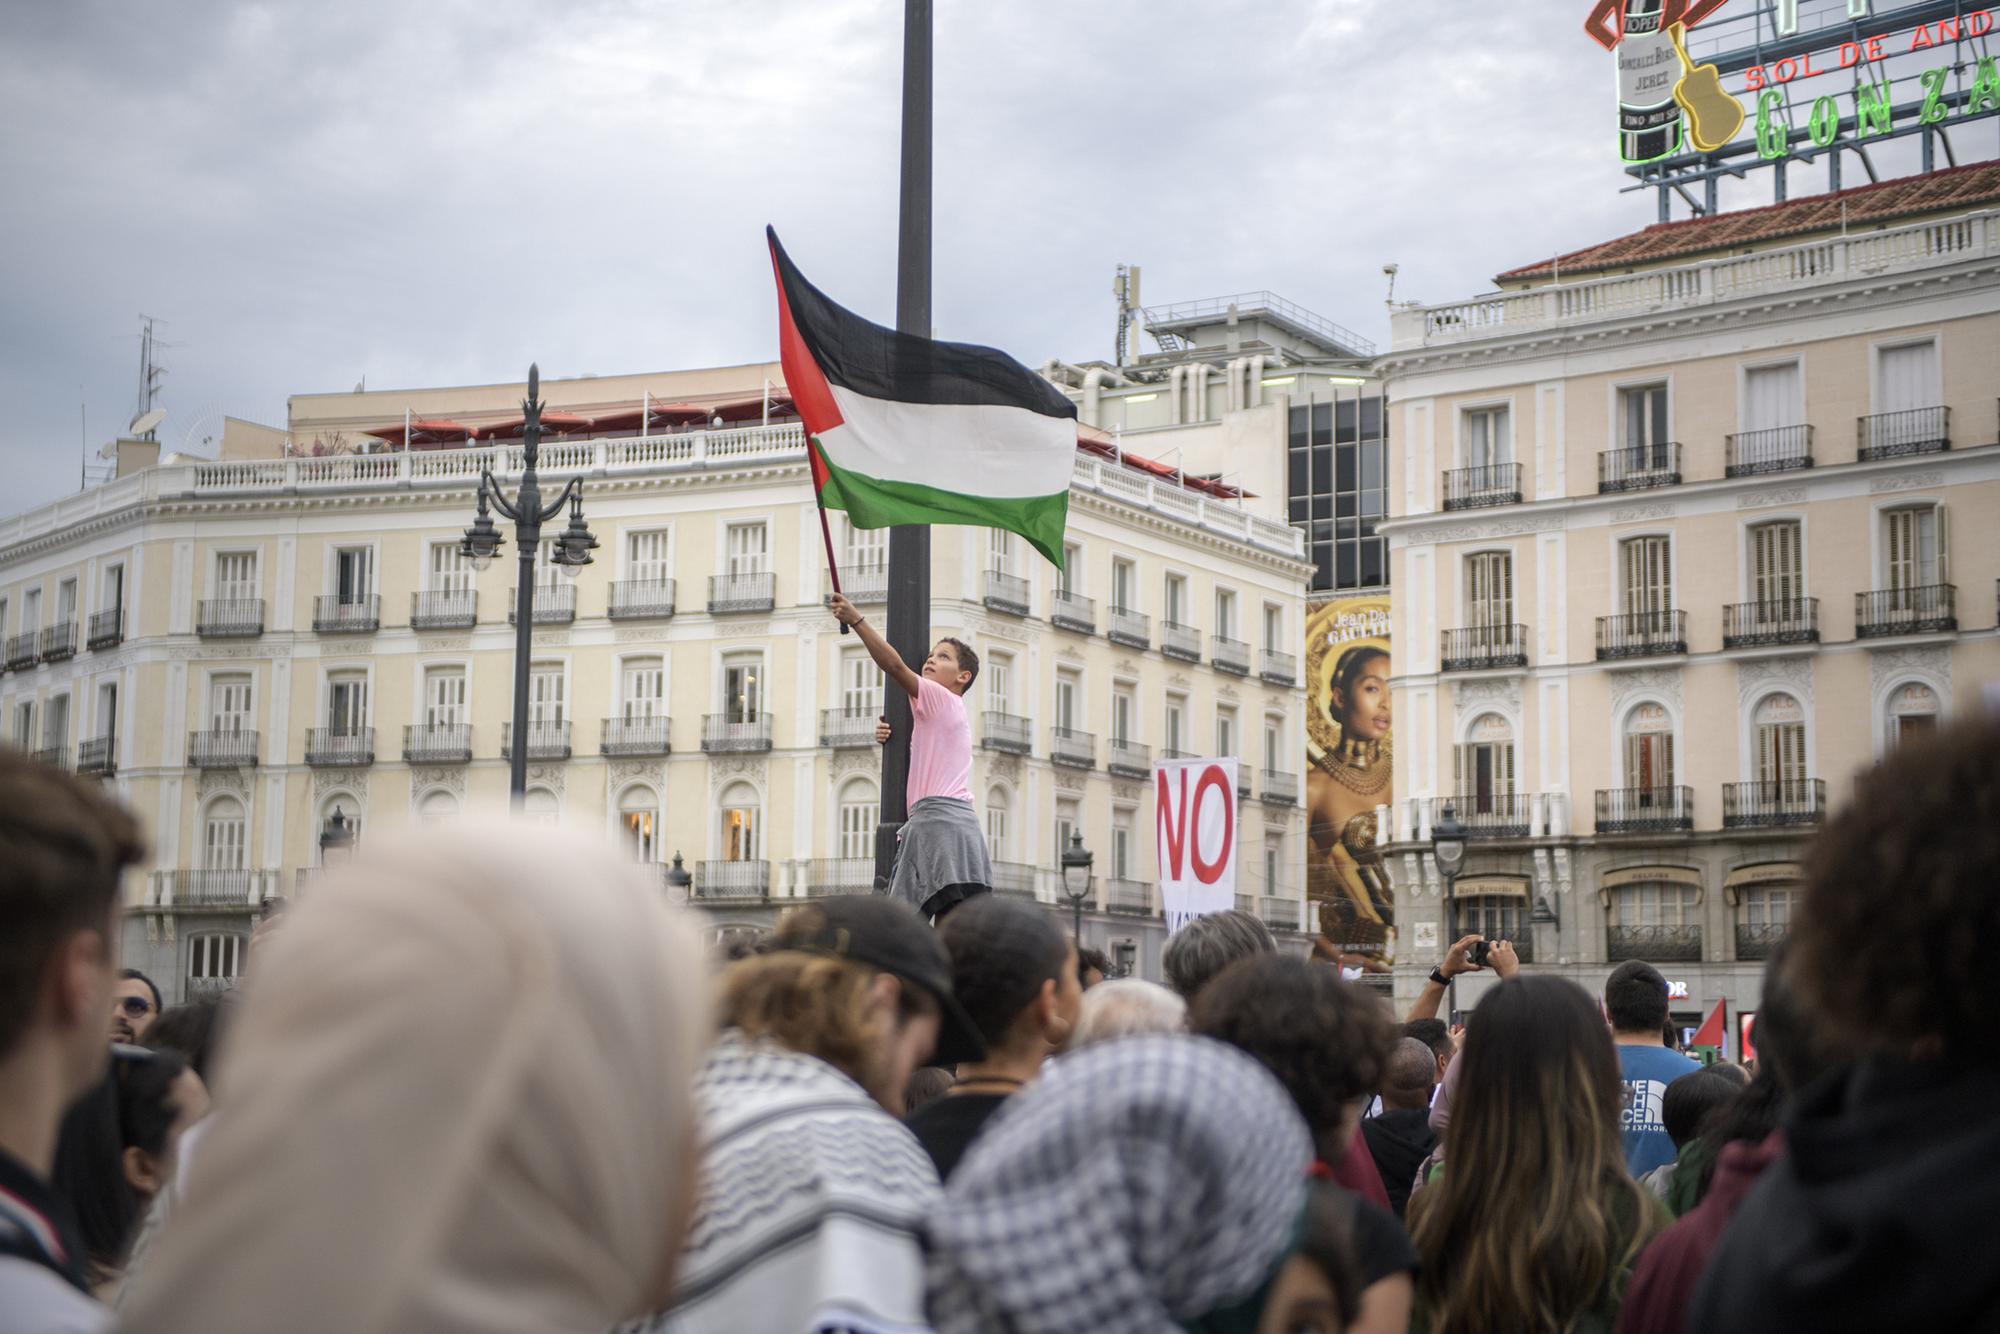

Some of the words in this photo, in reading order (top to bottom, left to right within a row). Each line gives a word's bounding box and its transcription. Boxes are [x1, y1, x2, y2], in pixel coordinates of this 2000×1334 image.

[1744, 53, 1824, 91] SOL
[1839, 33, 1889, 69] DE
[1909, 10, 1995, 53] AND
[1636, 71, 1669, 90] JEREZ
[1625, 115, 1645, 126] FINO
[1334, 613, 1367, 629] Jean
[1157, 765, 1233, 885] NO
[1664, 981, 1688, 996] OR
[1620, 1108, 1645, 1123] CE
